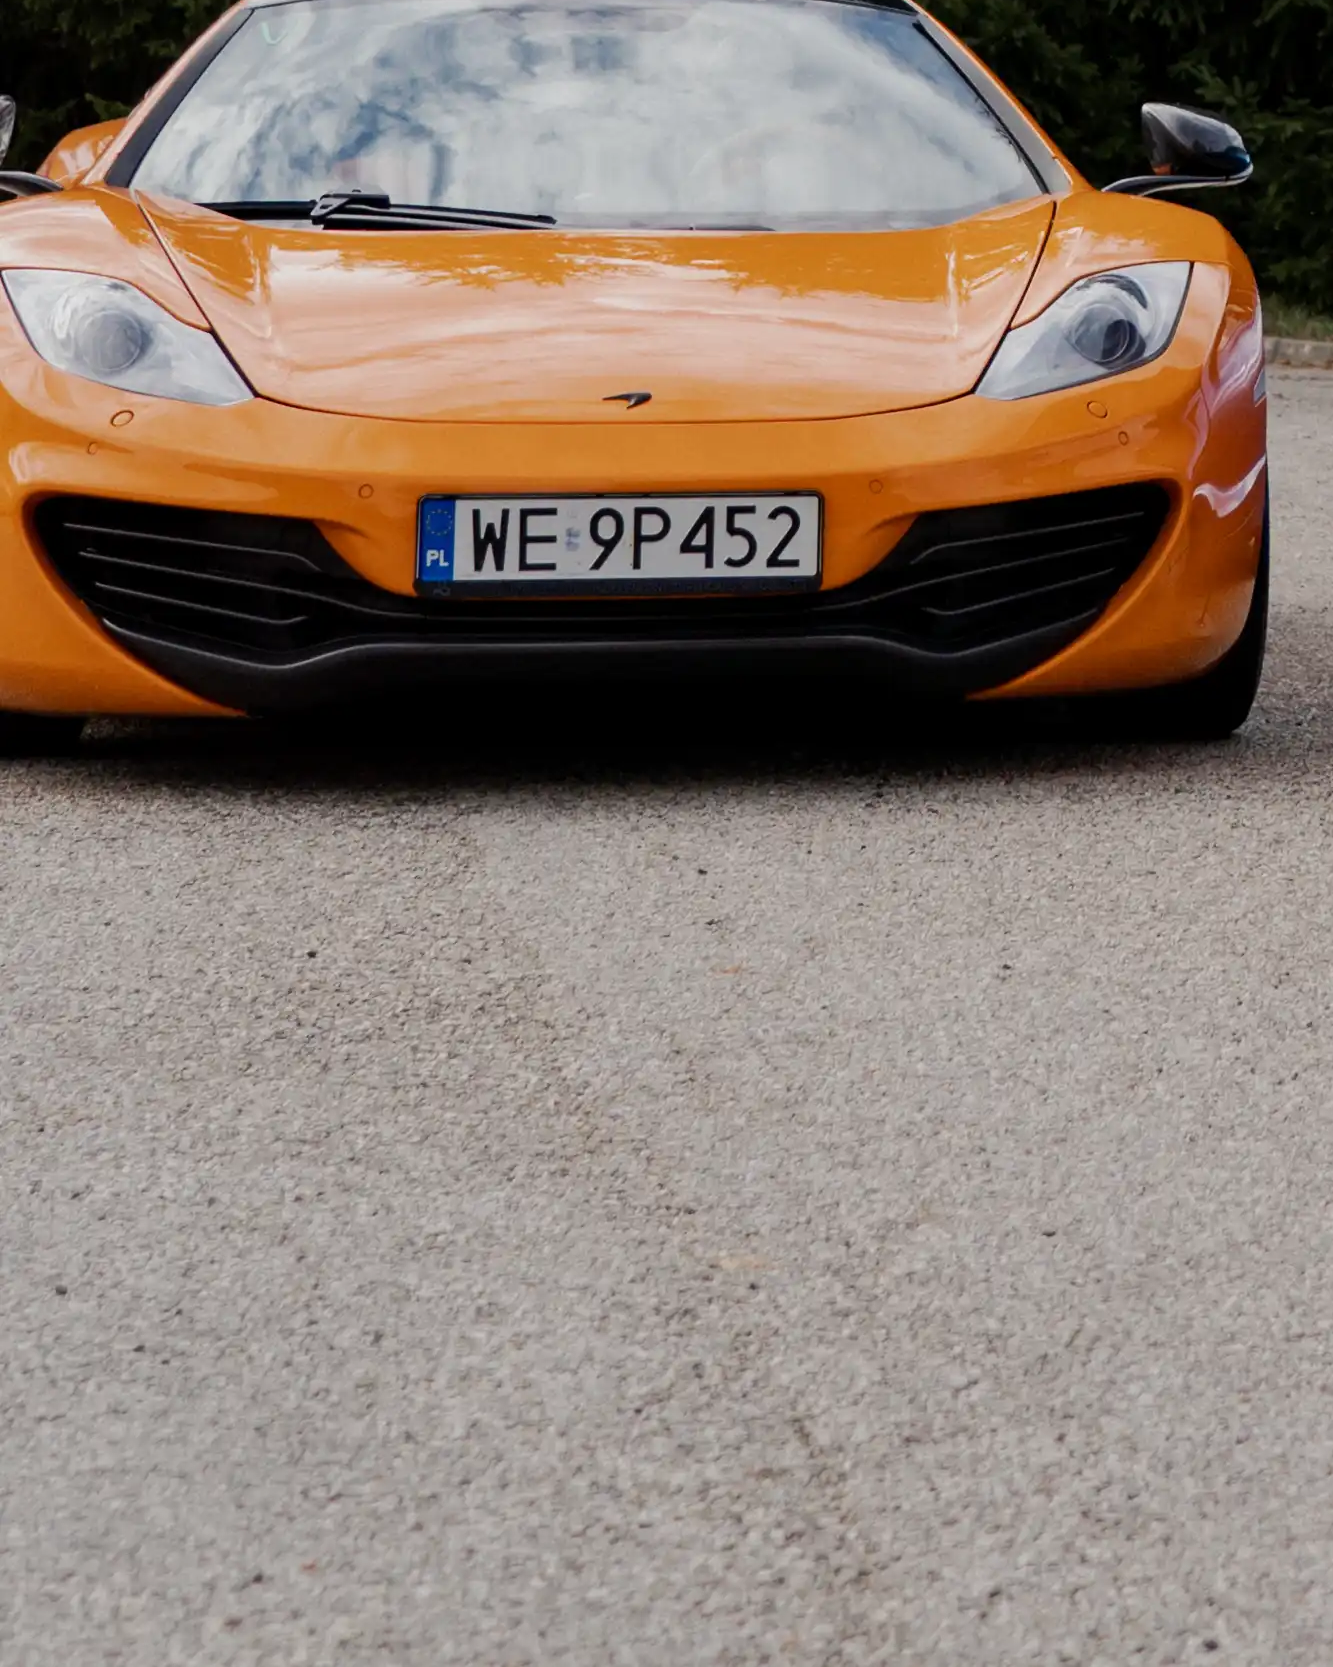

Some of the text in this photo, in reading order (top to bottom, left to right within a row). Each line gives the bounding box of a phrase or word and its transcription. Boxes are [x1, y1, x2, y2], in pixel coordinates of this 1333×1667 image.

[426, 549, 449, 567] PL
[472, 505, 801, 572] WE 9P452
